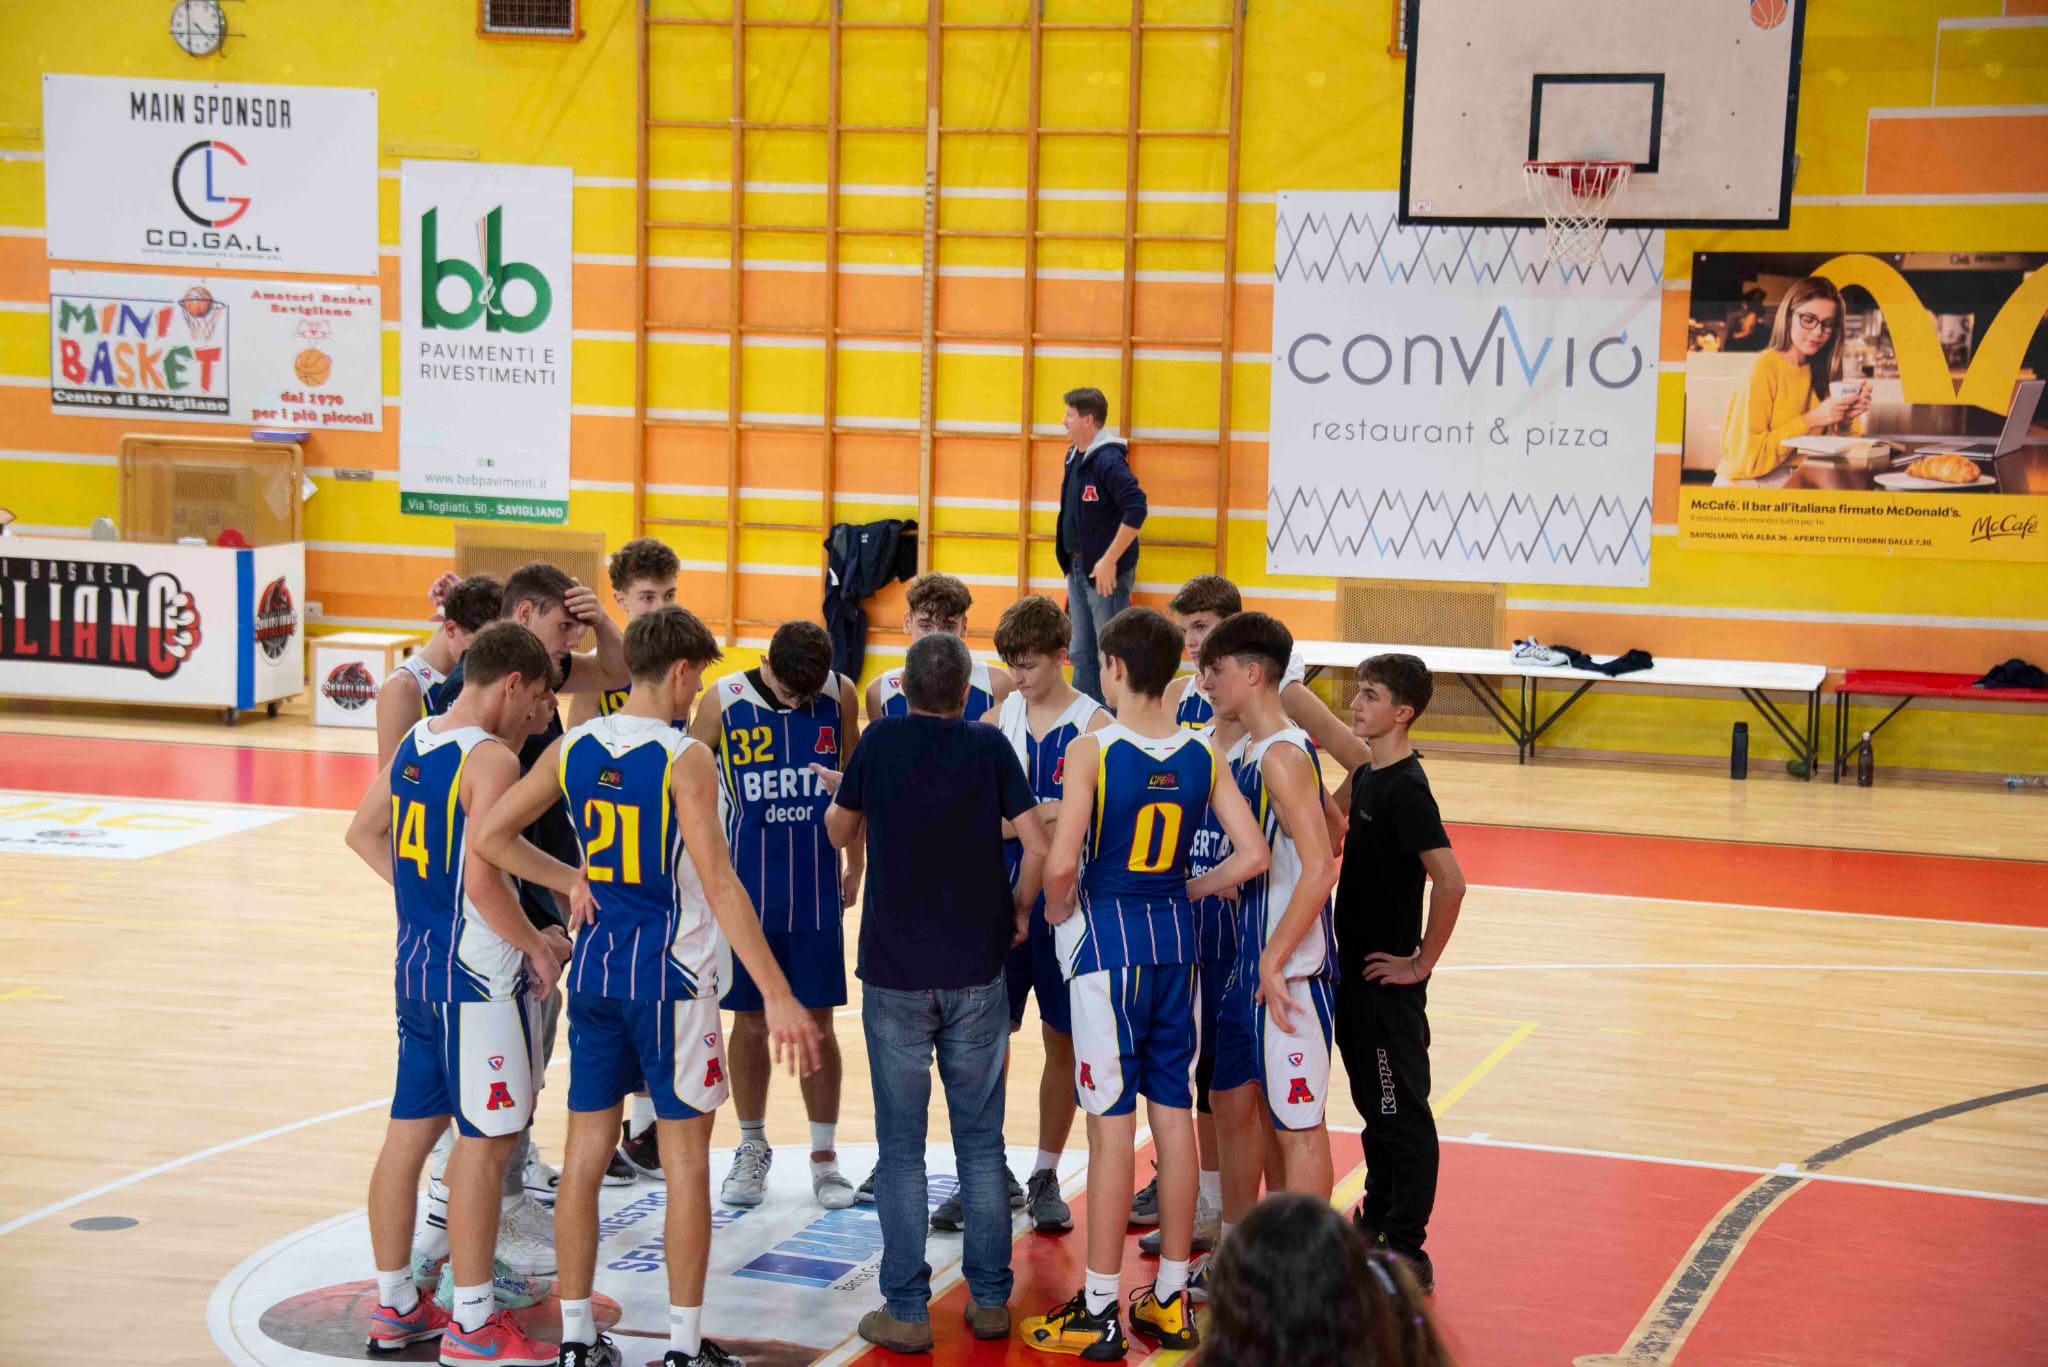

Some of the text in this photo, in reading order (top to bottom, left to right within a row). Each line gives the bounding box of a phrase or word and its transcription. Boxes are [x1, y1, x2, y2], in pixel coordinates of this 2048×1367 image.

[130, 91, 291, 129] MAIN SPONSOR
[251, 290, 314, 302] Amatori
[58, 298, 174, 339] MINI
[421, 342, 554, 364] PAVIMENTI E
[58, 338, 222, 392] BASKET
[421, 363, 555, 385] RIVESTIMENTI
[53, 390, 228, 412] Centro di Savigliano
[280, 391, 304, 404] dal
[252, 408, 278, 421] per
[282, 408, 288, 420] i
[322, 410, 374, 425] piccoli
[1313, 417, 1609, 456] restaurant & pizza
[425, 473, 547, 489] www.bebpavimenti.it
[407, 499, 425, 511] Via
[475, 503, 487, 514] 50
[496, 504, 563, 519] SAVIGLIANO
[1742, 501, 1750, 511] Il
[1752, 501, 1771, 512] bar
[1774, 501, 1836, 514] all'italiana
[1839, 503, 1884, 516] firmato
[1886, 505, 1962, 518] McDonald's.
[1741, 532, 1754, 540] VIA
[1755, 533, 1777, 541] ALBA
[1793, 535, 1826, 543] APERTO
[1827, 536, 1851, 544] TUTTI
[1857, 537, 1886, 545] GIORNI
[1888, 538, 1914, 546] DALLE
[30, 560, 131, 585] BASKET
[0, 573, 184, 674] LIANO
[730, 726, 775, 766] 32
[765, 804, 814, 823] decor
[391, 794, 430, 881] 14
[584, 799, 643, 885] 21
[1127, 801, 1183, 874] 0
[1377, 1048, 1397, 1114] Kappa
